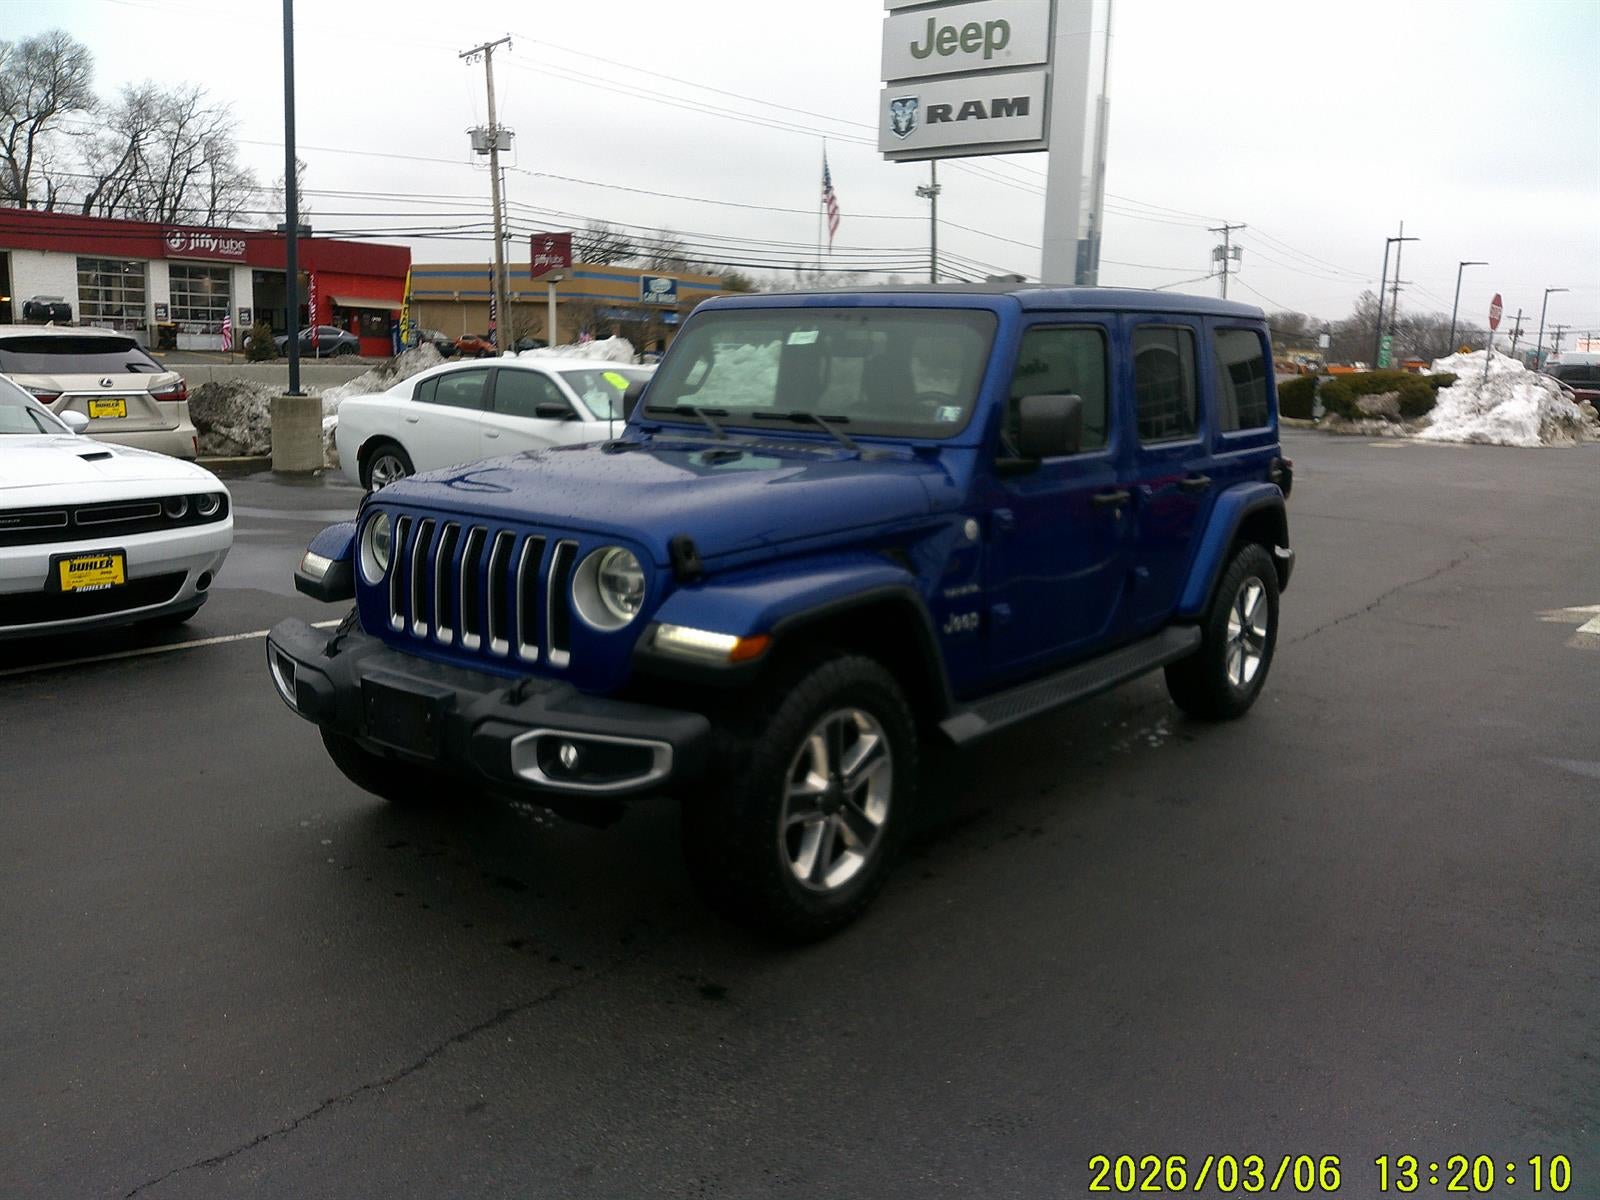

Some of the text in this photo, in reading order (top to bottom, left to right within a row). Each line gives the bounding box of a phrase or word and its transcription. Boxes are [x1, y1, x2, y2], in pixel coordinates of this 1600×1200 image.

[910, 17, 1011, 60] Jeep
[926, 96, 1030, 124] RAM
[188, 232, 218, 252] jiffy
[219, 237, 246, 251] lube
[69, 559, 114, 572] BUHLER
[76, 583, 112, 593] BUHLER
